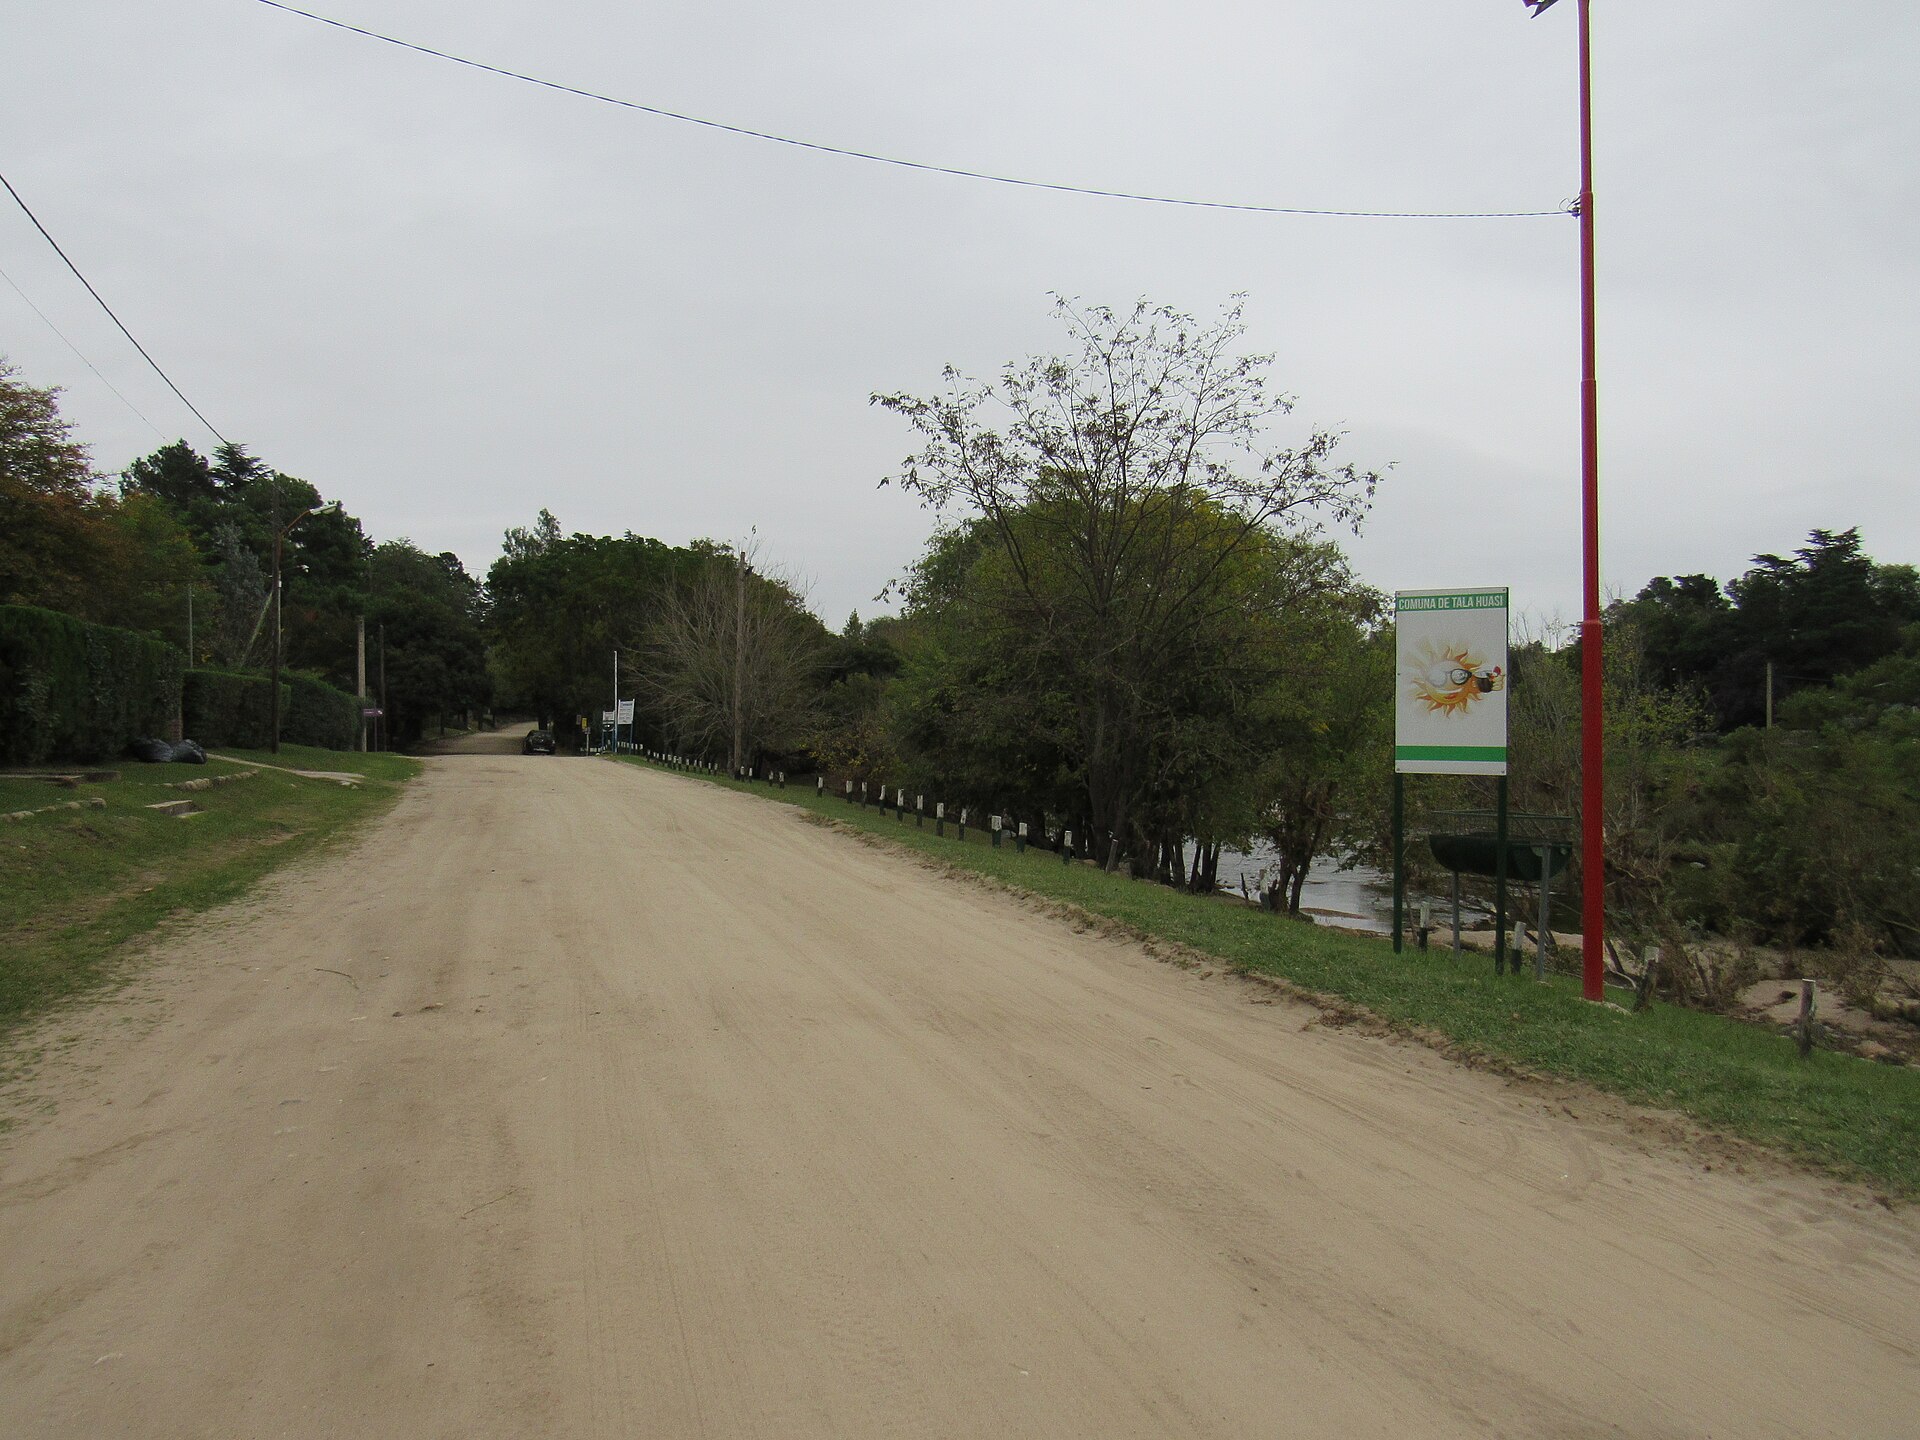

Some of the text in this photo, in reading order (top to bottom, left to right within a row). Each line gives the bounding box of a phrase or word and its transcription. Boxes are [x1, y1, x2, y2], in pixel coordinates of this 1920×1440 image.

[1398, 595, 1503, 610] COMUNA DE TALA HUASI
